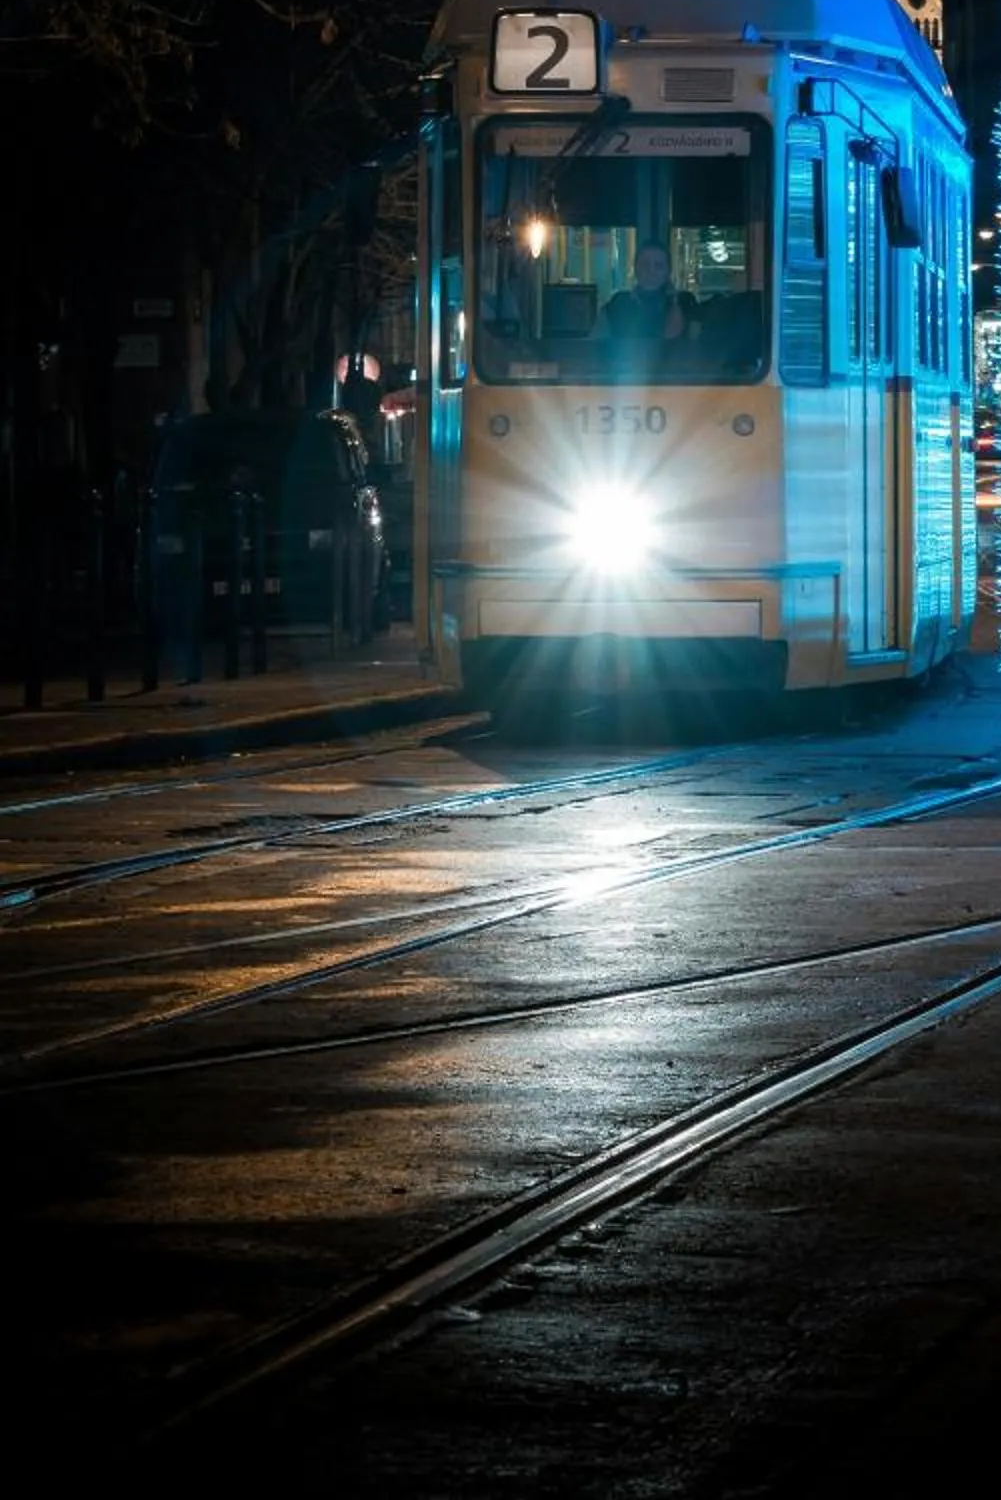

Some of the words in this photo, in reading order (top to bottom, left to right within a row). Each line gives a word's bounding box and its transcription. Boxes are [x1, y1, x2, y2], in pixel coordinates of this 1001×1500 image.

[525, 25, 570, 89] 2
[613, 131, 630, 153] 2
[575, 405, 667, 435] 1350
